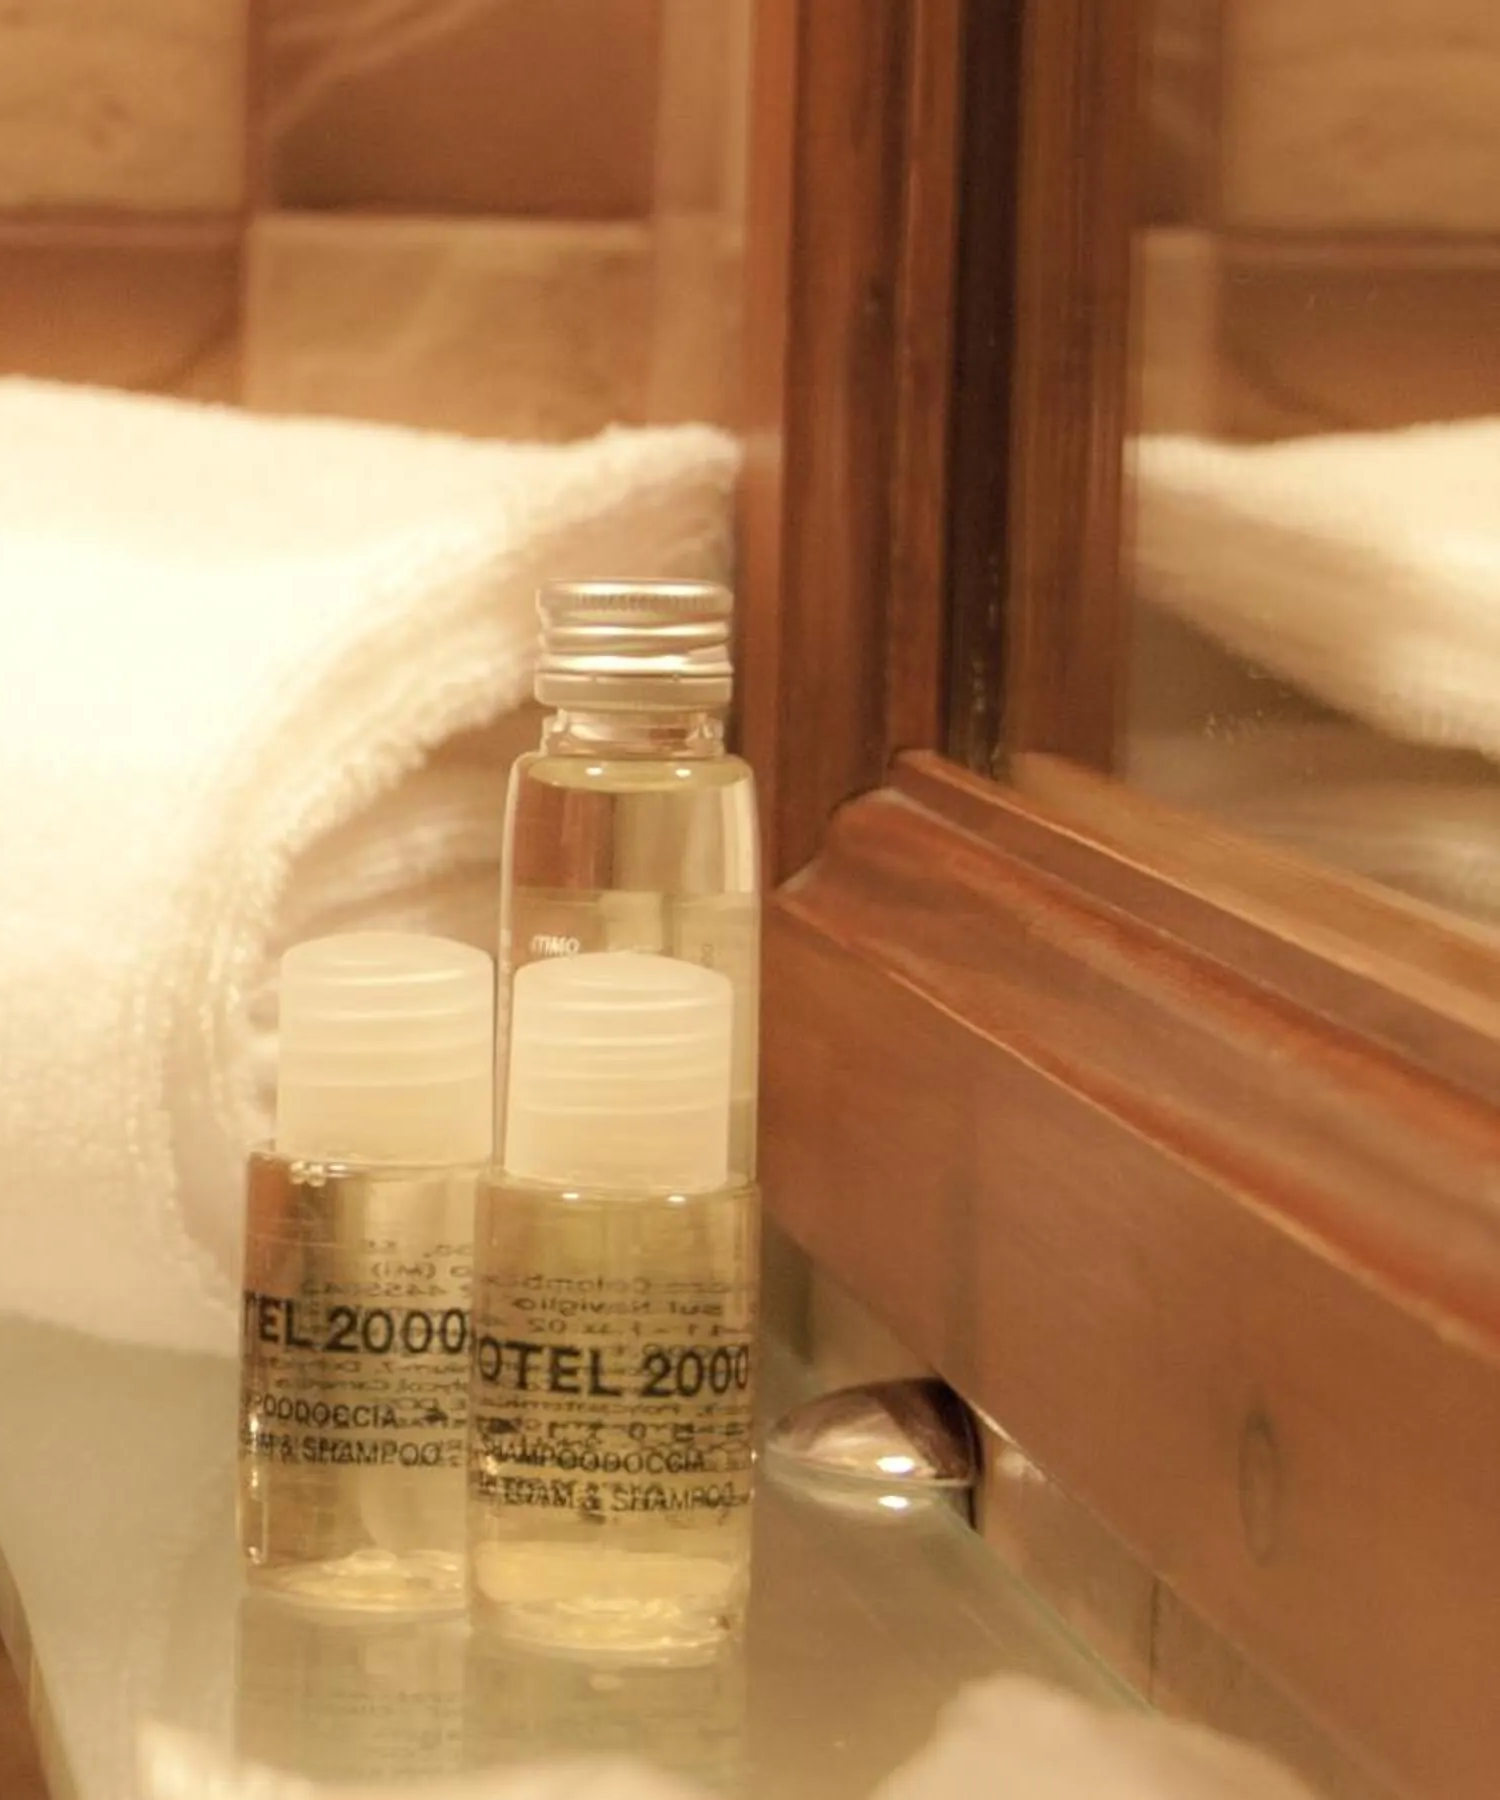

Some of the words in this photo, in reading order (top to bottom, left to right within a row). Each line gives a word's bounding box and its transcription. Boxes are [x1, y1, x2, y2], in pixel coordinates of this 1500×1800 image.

[326, 1306, 467, 1353] 2000
[639, 1345, 749, 1397] 2000
[302, 1436, 440, 1467] SHAMPOO
